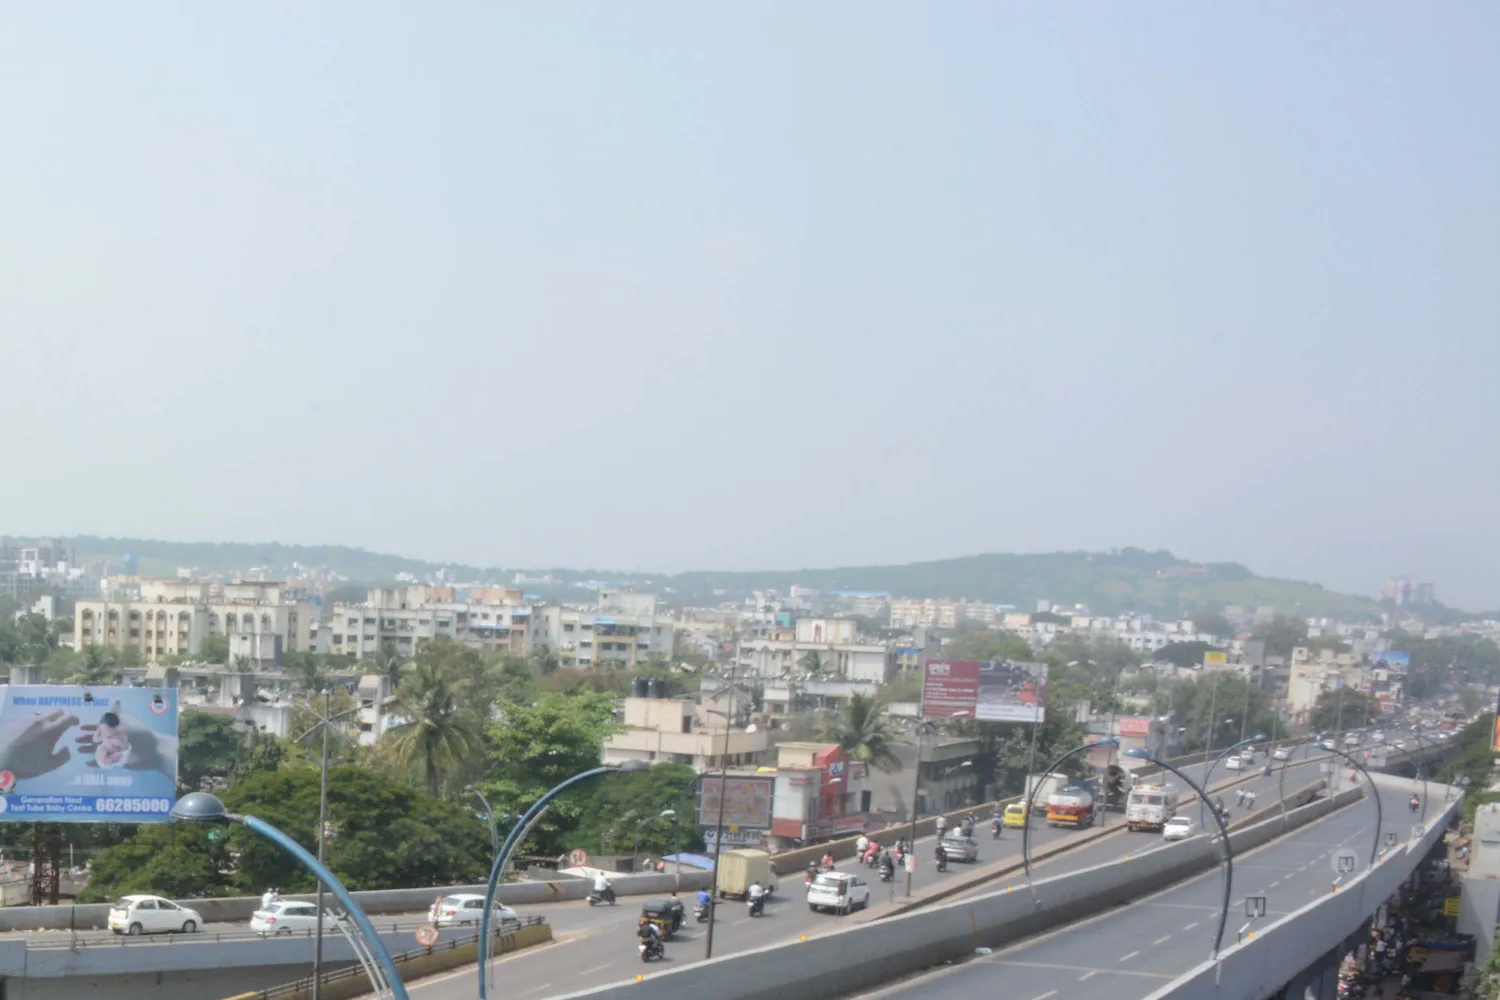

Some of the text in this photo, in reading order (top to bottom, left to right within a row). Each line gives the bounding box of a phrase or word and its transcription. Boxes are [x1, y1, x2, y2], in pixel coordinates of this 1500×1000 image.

[13, 695, 37, 706] When
[38, 695, 82, 706] HAPPINESS
[20, 796, 83, 804] Generation Next
[11, 804, 26, 812] Test
[27, 804, 45, 812] Tube
[46, 804, 65, 813] Baby
[96, 798, 170, 813] 66285000
